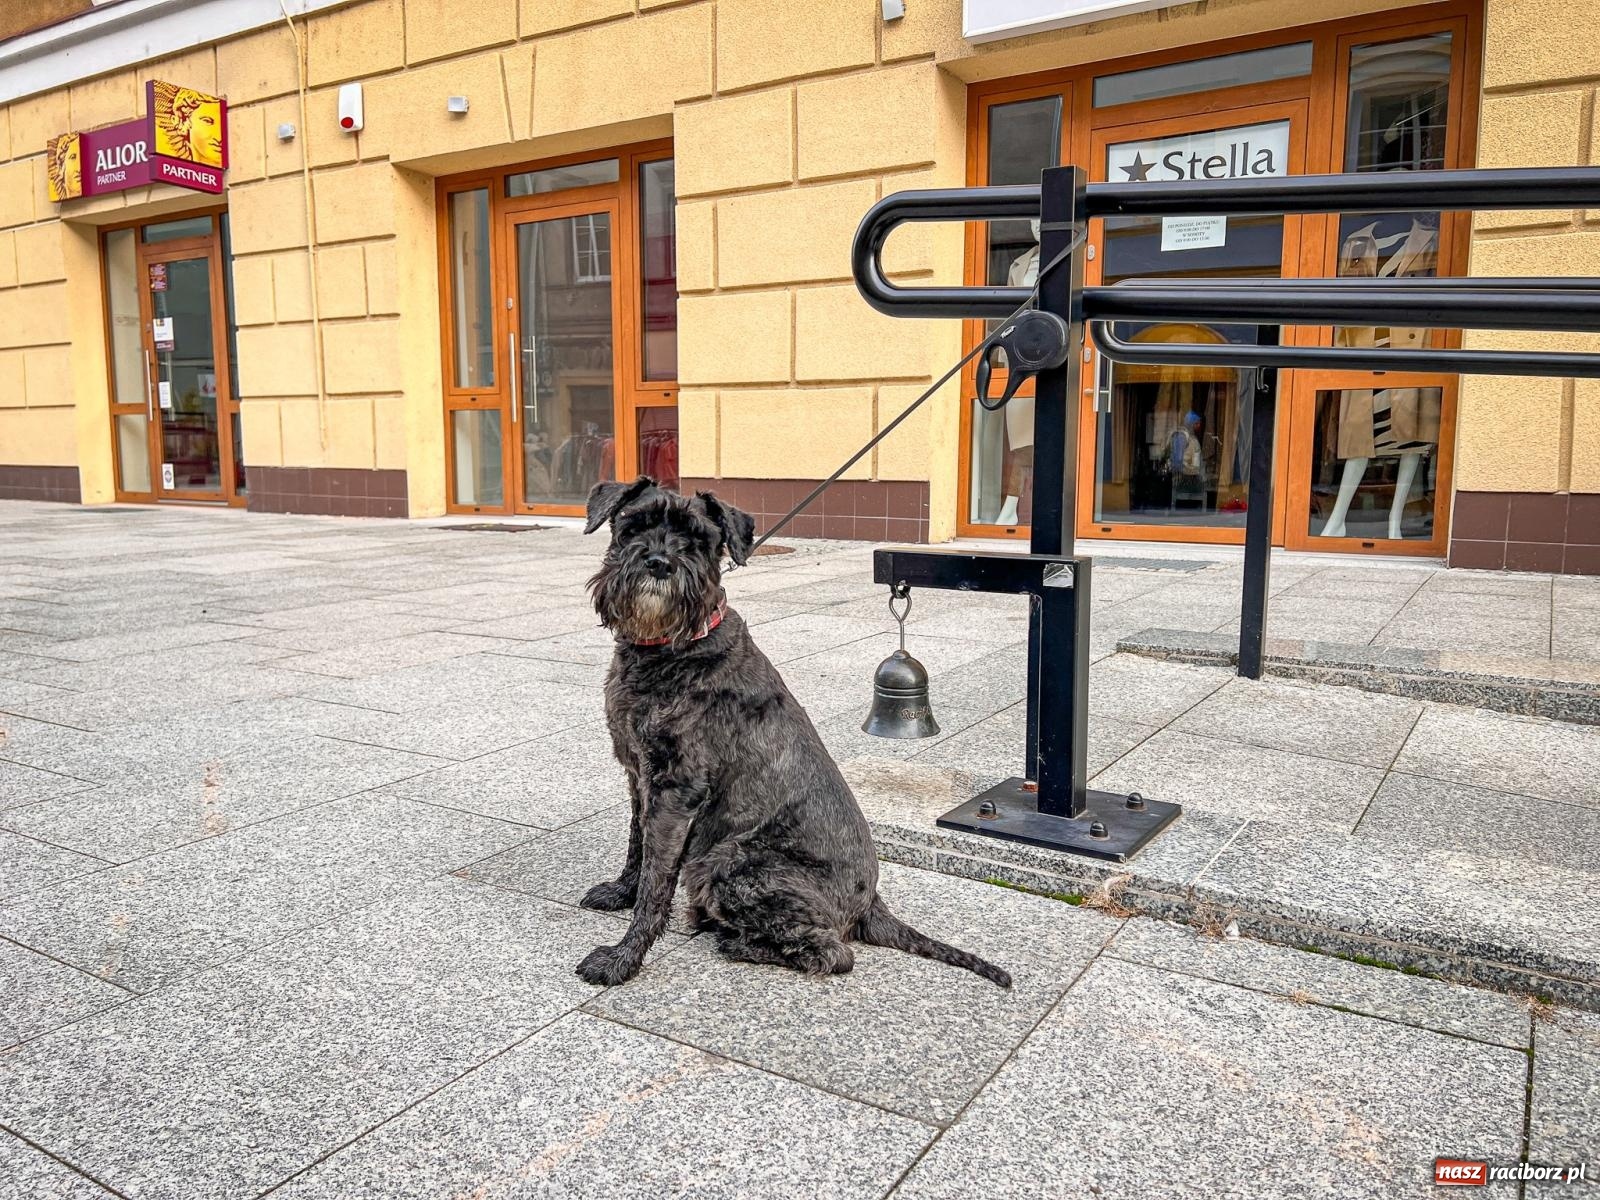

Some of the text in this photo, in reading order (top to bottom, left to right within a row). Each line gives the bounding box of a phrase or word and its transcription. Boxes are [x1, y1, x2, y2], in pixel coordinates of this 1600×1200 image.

[96, 141, 148, 172] ALIOR
[1162, 141, 1276, 181] Stella
[97, 171, 127, 186] PARTNER
[162, 163, 217, 186] PARTNER
